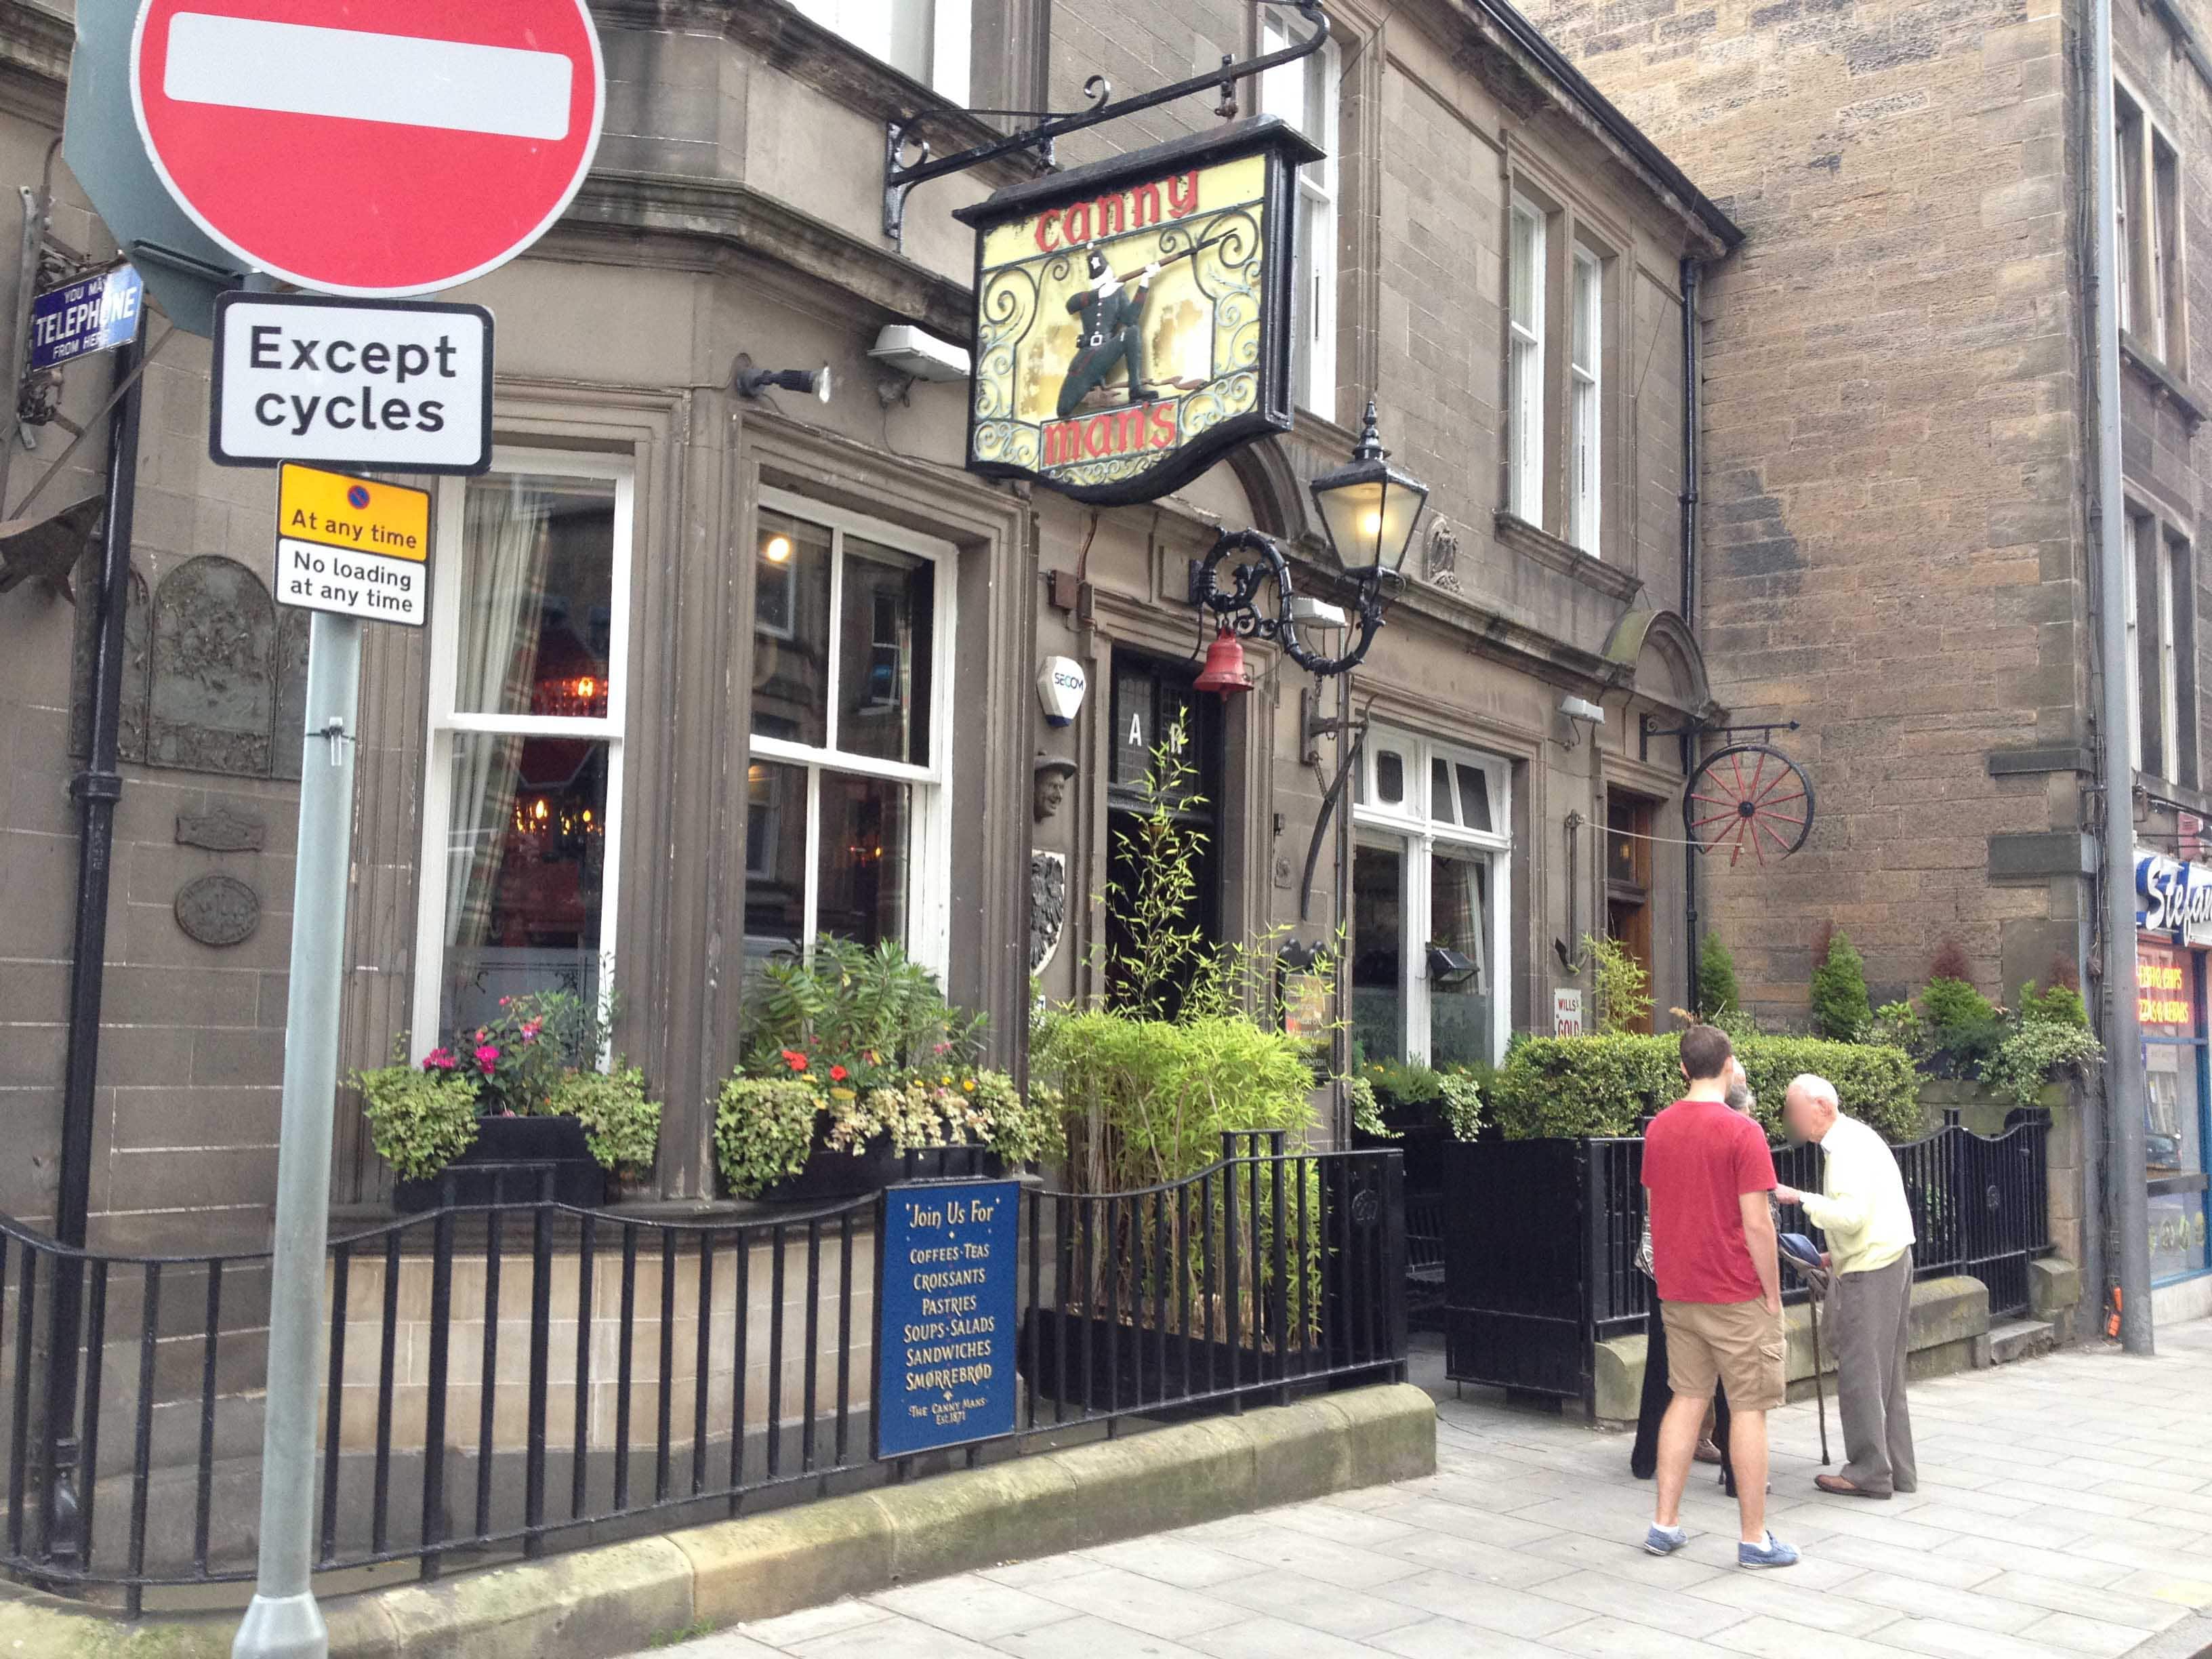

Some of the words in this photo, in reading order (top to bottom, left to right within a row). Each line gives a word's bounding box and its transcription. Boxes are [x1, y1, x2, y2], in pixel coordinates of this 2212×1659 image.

[1035, 169, 1197, 253] canny
[64, 286, 85, 304] YOU
[37, 287, 137, 347] TELEPHONE
[53, 340, 80, 359] FROM
[249, 325, 457, 382] Except
[255, 386, 446, 435] cycles
[292, 509, 317, 530] At
[325, 519, 363, 541] any
[371, 525, 417, 549] time
[294, 550, 325, 573] No
[333, 558, 411, 592] loading
[290, 578, 313, 596] at
[321, 585, 359, 607] any
[367, 589, 413, 613] time
[1054, 672, 1084, 691] SECOM
[947, 1201, 965, 1225] Us
[971, 1200, 994, 1223] For
[914, 1268, 985, 1293] CROISSANTS
[922, 1295, 977, 1317] PASTRIES
[906, 1339, 991, 1368] SANDWICHES
